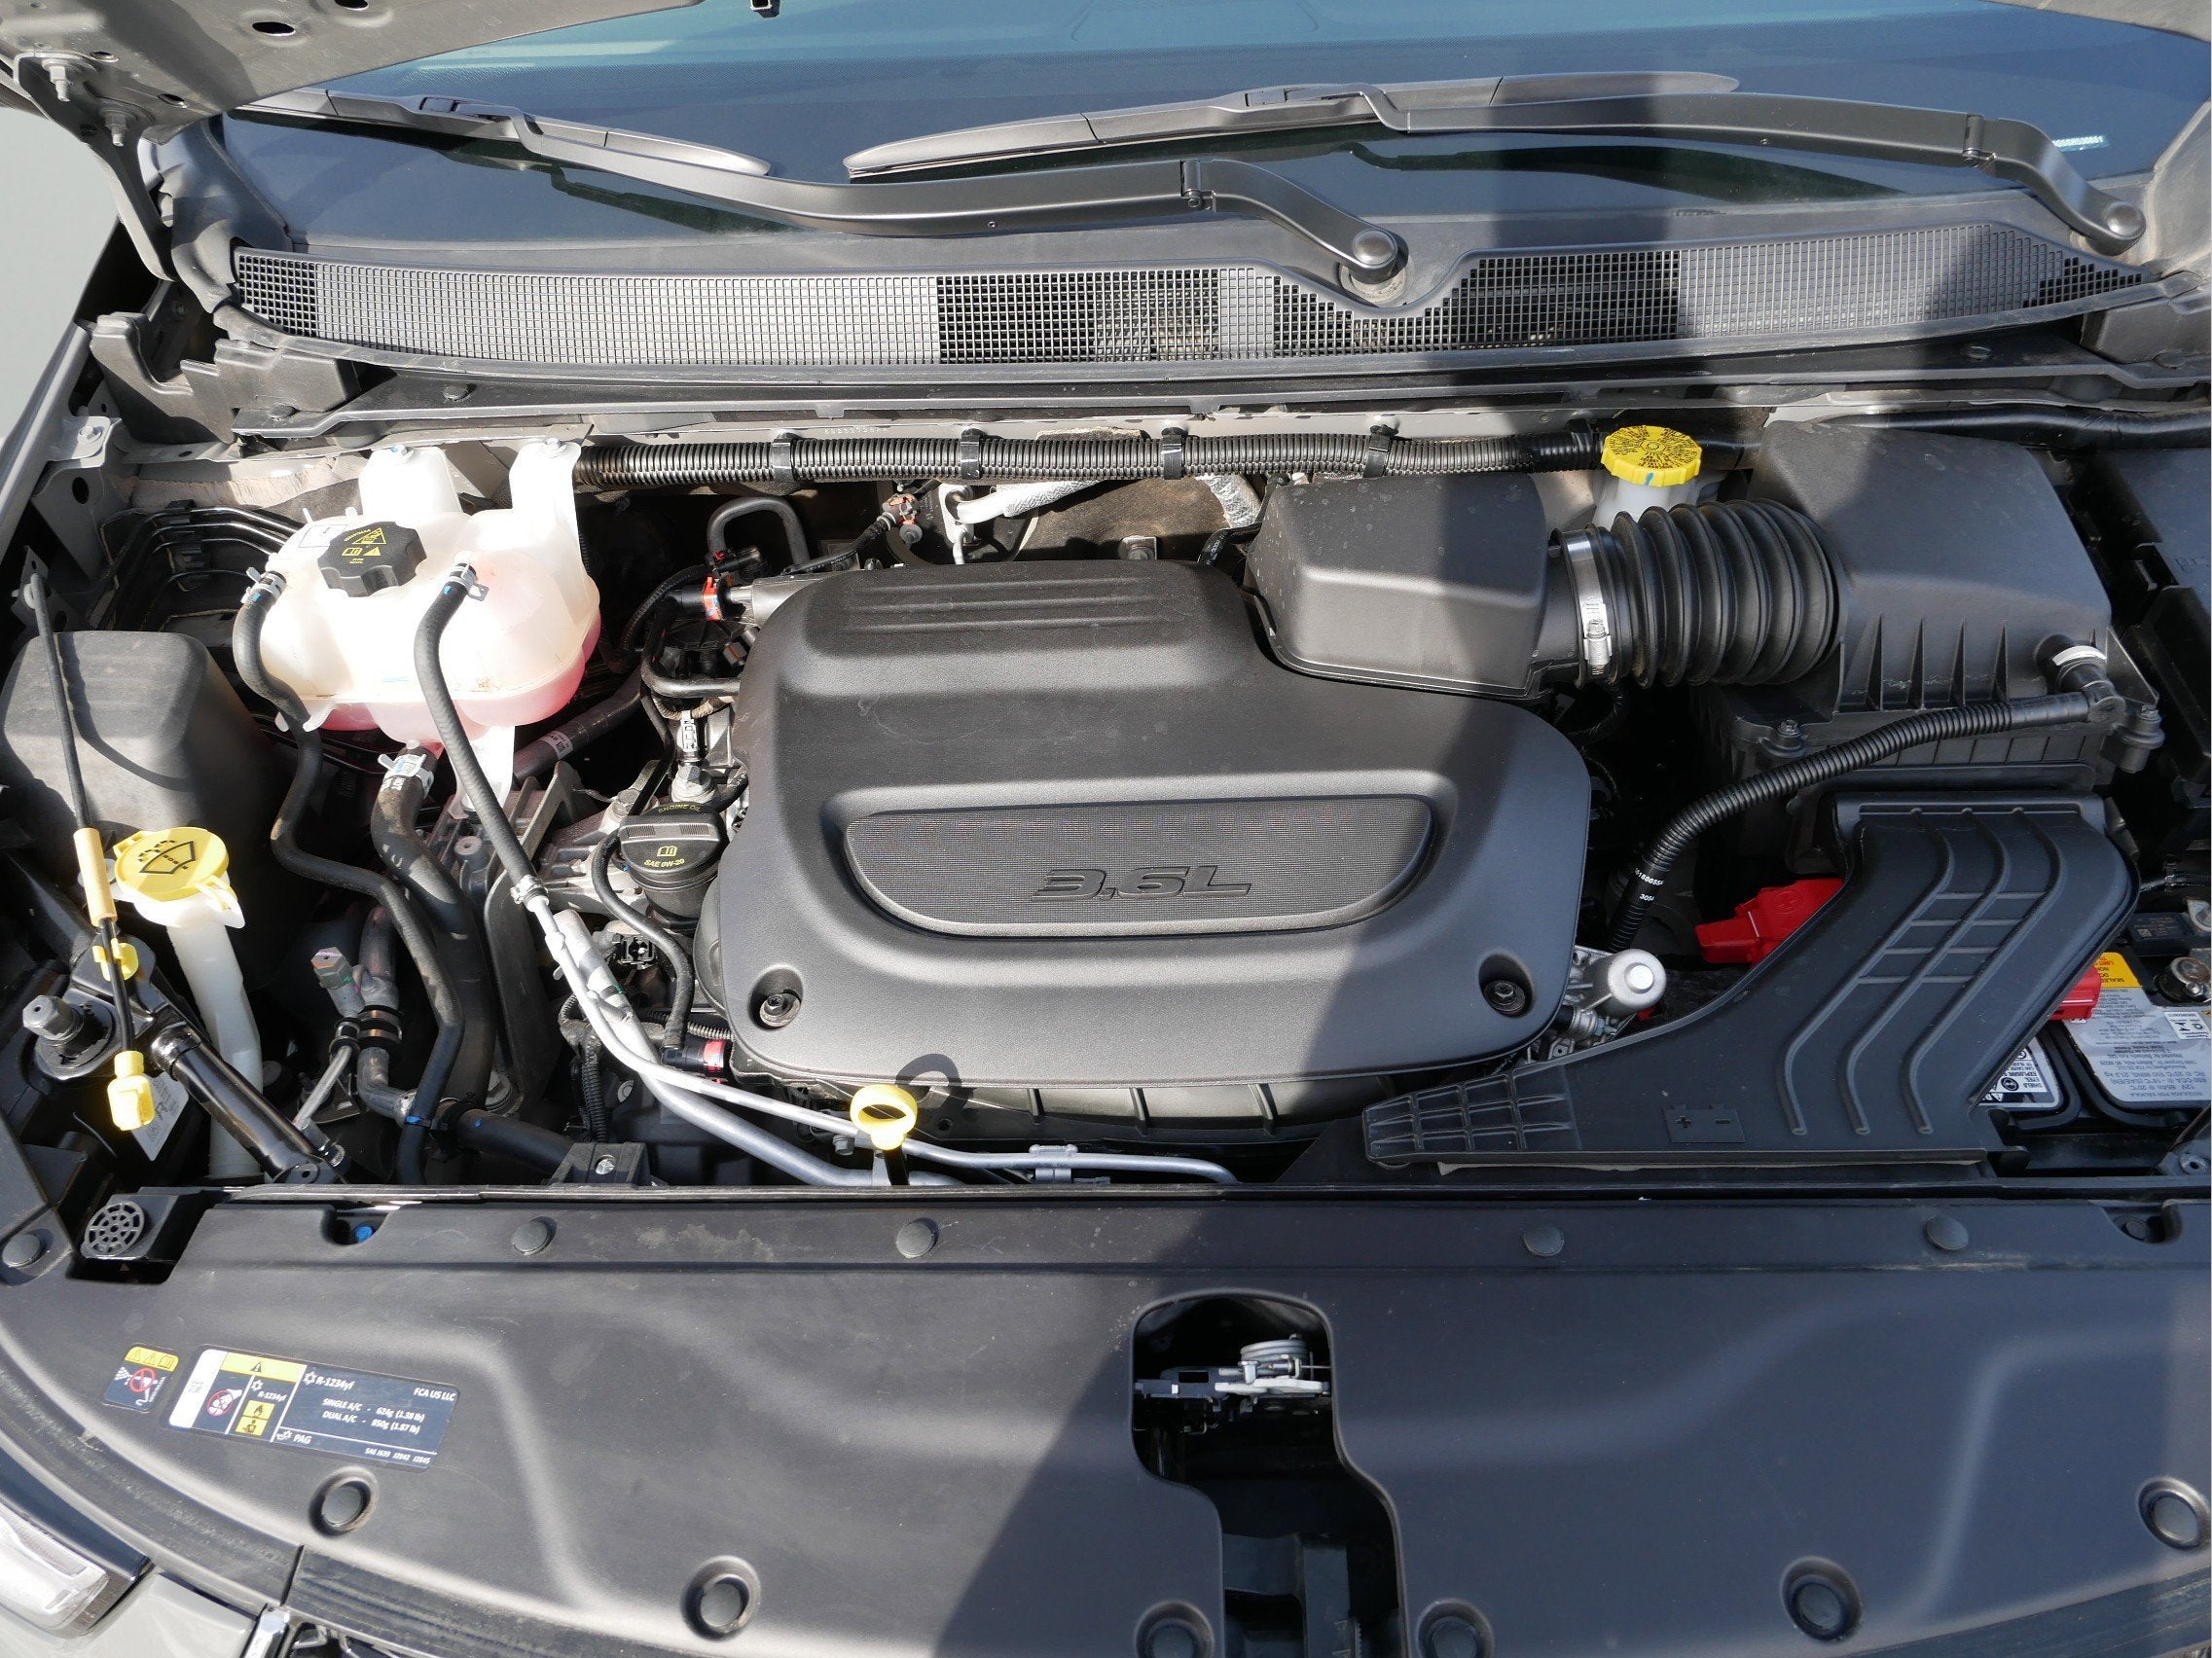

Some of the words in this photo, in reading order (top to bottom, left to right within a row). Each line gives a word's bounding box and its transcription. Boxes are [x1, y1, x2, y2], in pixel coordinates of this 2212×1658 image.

[661, 858, 685, 867] 0W-20
[1032, 864, 1252, 903] 3.6L
[315, 1377, 355, 1390] R-1234yf
[414, 1388, 429, 1398] FCA
[429, 1389, 442, 1400] US
[442, 1391, 456, 1402] LLC
[322, 1398, 348, 1409] SINGLE
[347, 1402, 363, 1411] A/C
[376, 1407, 394, 1418] 624g
[395, 1410, 415, 1421] (1.38
[322, 1410, 343, 1421] DUAL
[342, 1414, 358, 1423] A/C
[371, 1419, 389, 1429] 850g
[293, 1433, 311, 1444] PAG
[365, 1447, 378, 1456] SAE
